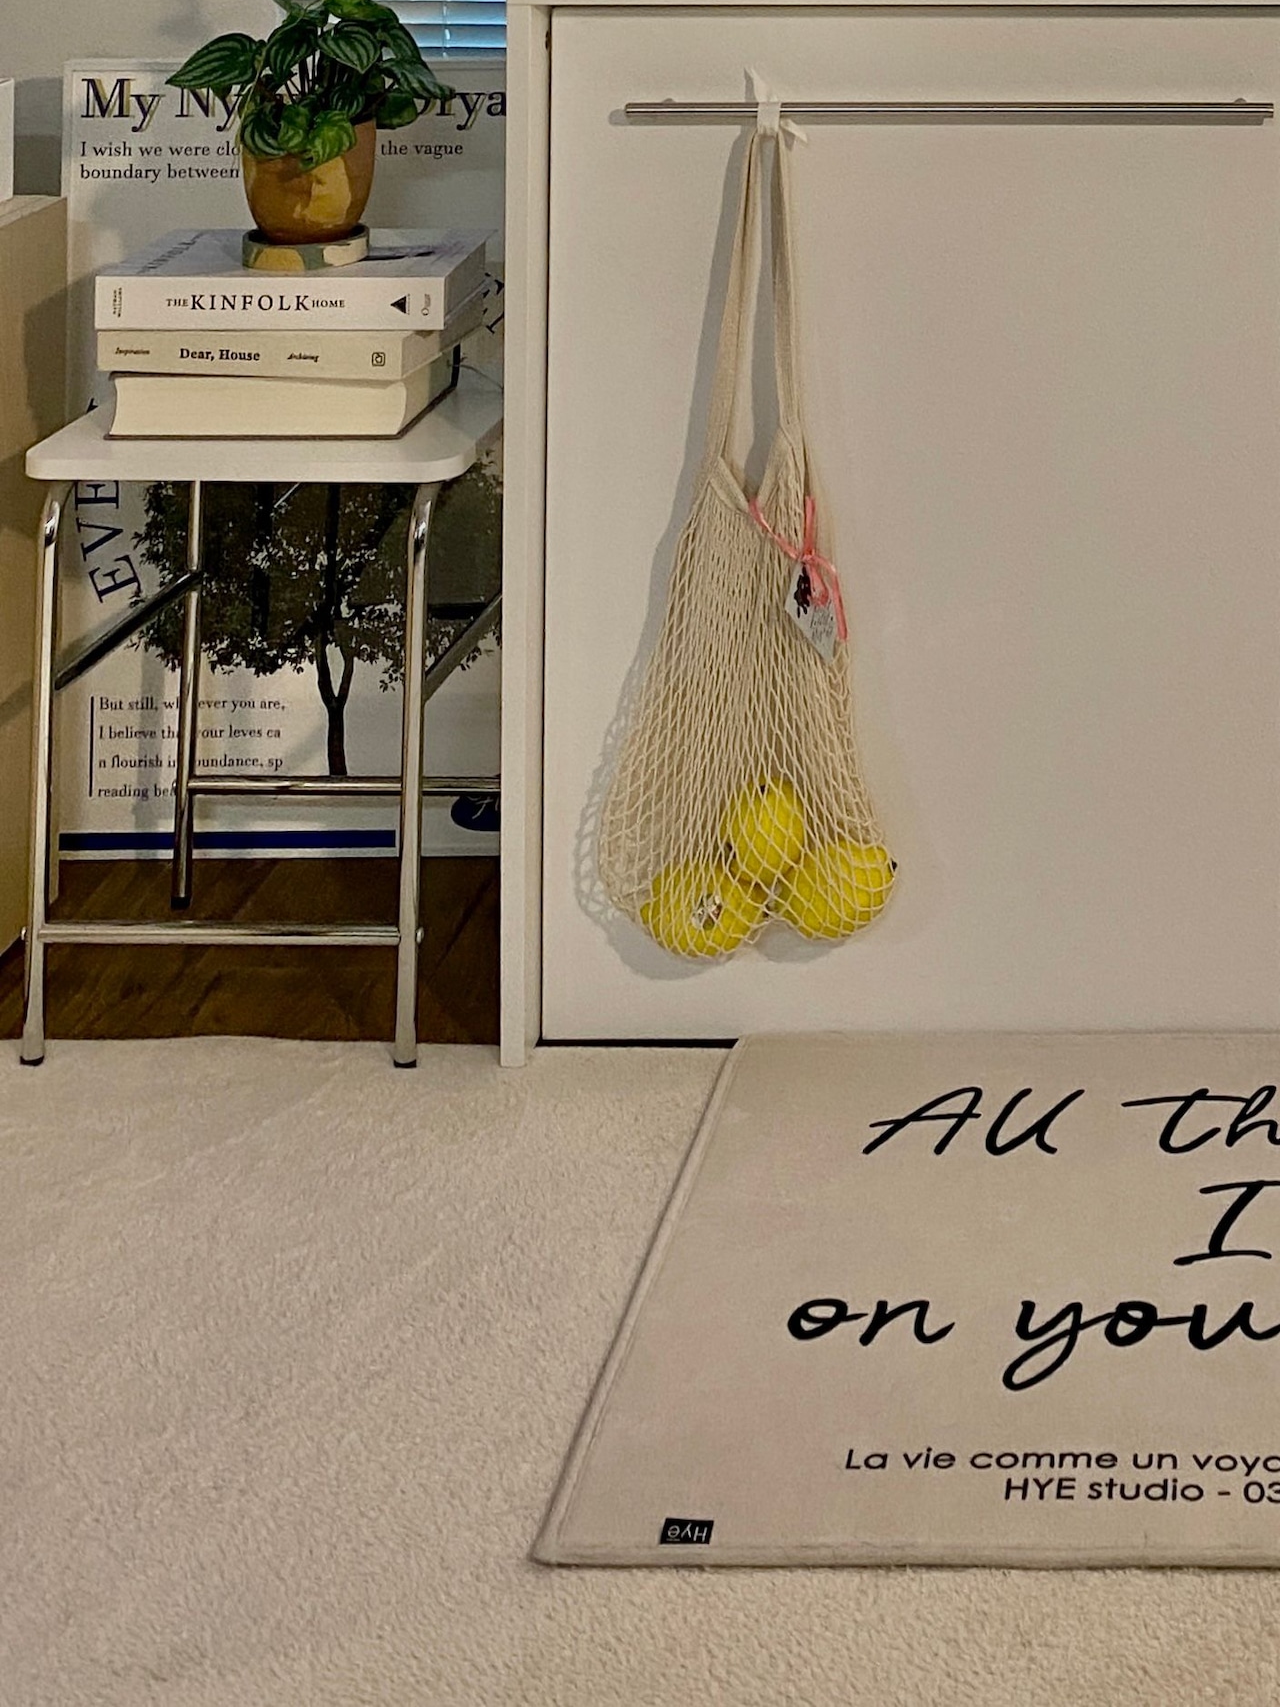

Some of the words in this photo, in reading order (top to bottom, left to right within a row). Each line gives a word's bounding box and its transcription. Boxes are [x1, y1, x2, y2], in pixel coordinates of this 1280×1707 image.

[81, 78, 166, 132] My
[80, 141, 87, 157] I
[92, 141, 132, 157] wish
[139, 145, 162, 157] we
[169, 145, 210, 157] were
[380, 140, 408, 156] the
[414, 144, 464, 159] vague
[80, 163, 161, 183] boundary
[167, 163, 240, 179] between
[166, 298, 189, 307] THE
[190, 294, 310, 311] KINFOLK
[311, 298, 346, 308] HOME
[179, 348, 215, 362] Dear,
[218, 349, 261, 361] House
[99, 696, 123, 710] But
[128, 695, 158, 711] still,
[231, 700, 256, 713] you
[108, 725, 157, 739] believe
[111, 754, 162, 768] flourish
[98, 784, 150, 802] reading
[862, 1086, 1086, 1156] All
[786, 1297, 957, 1348] on
[844, 1448, 889, 1470] La
[902, 1446, 957, 1470] vie
[969, 1451, 1119, 1470] comme
[1131, 1453, 1180, 1470] un
[1003, 1477, 1078, 1501] HYE
[1087, 1477, 1206, 1502] studio
